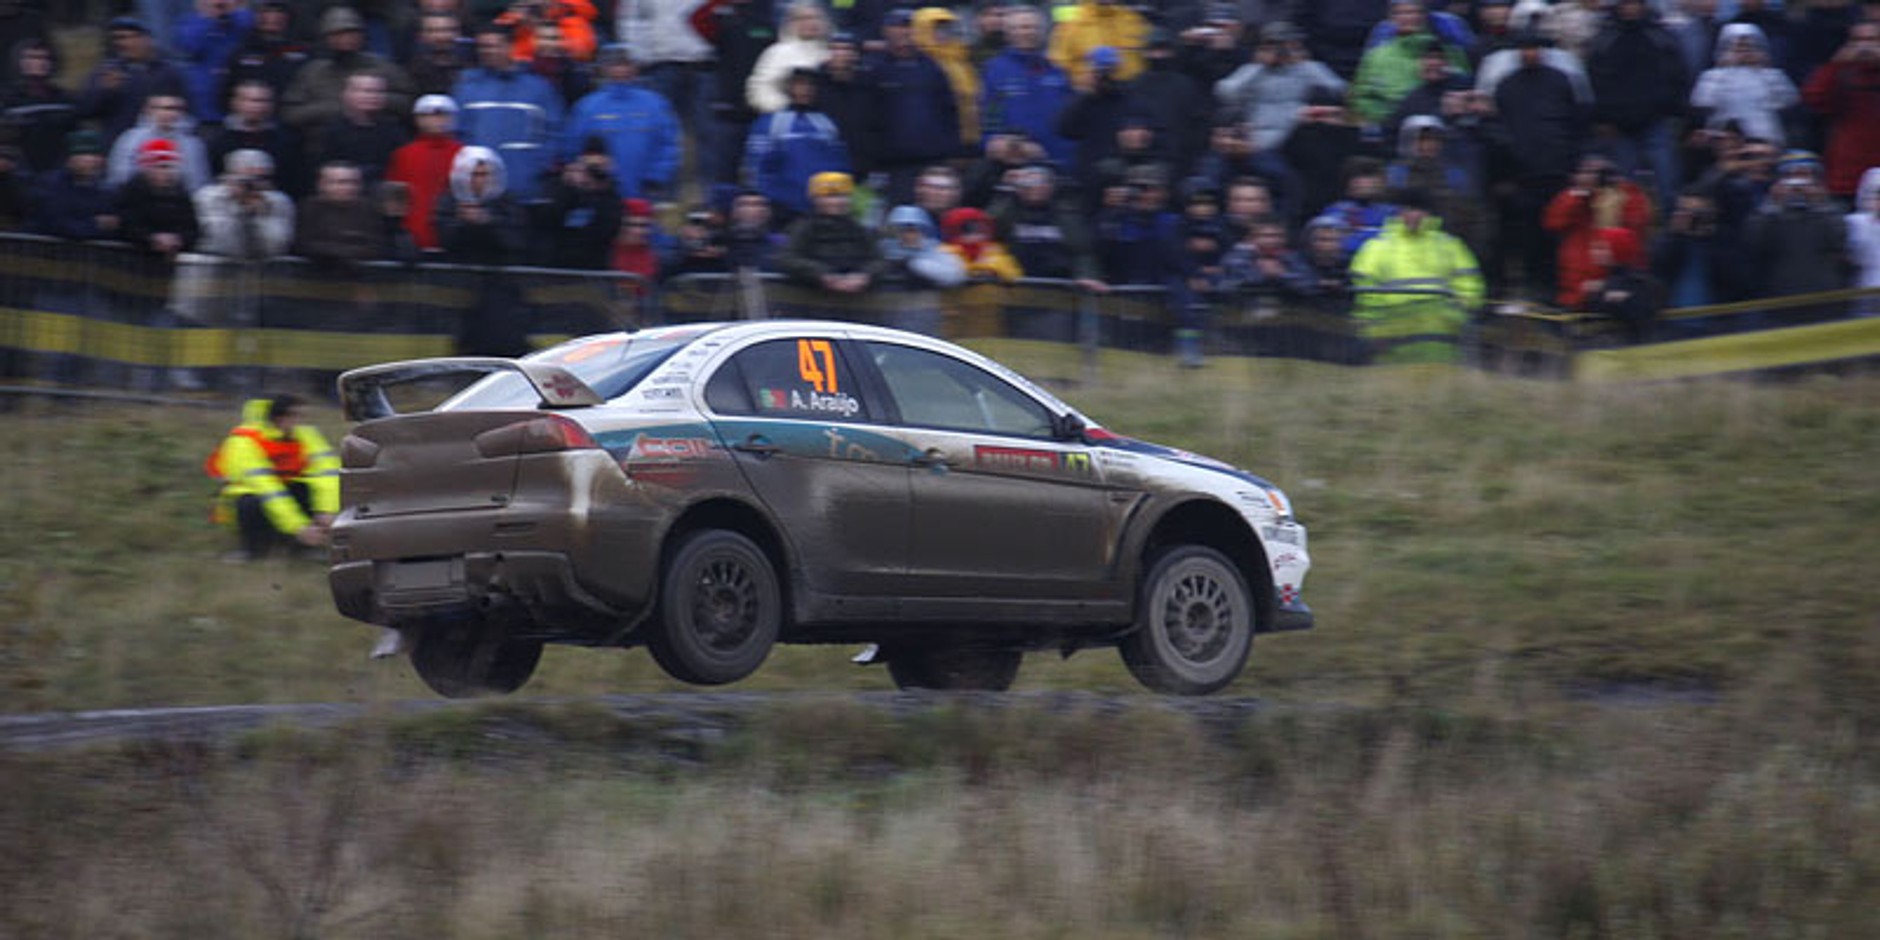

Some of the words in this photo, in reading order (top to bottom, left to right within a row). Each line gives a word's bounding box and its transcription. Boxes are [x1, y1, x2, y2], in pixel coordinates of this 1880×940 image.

[797, 338, 838, 393] 47
[791, 389, 807, 408] A.
[1066, 453, 1090, 472] 47
